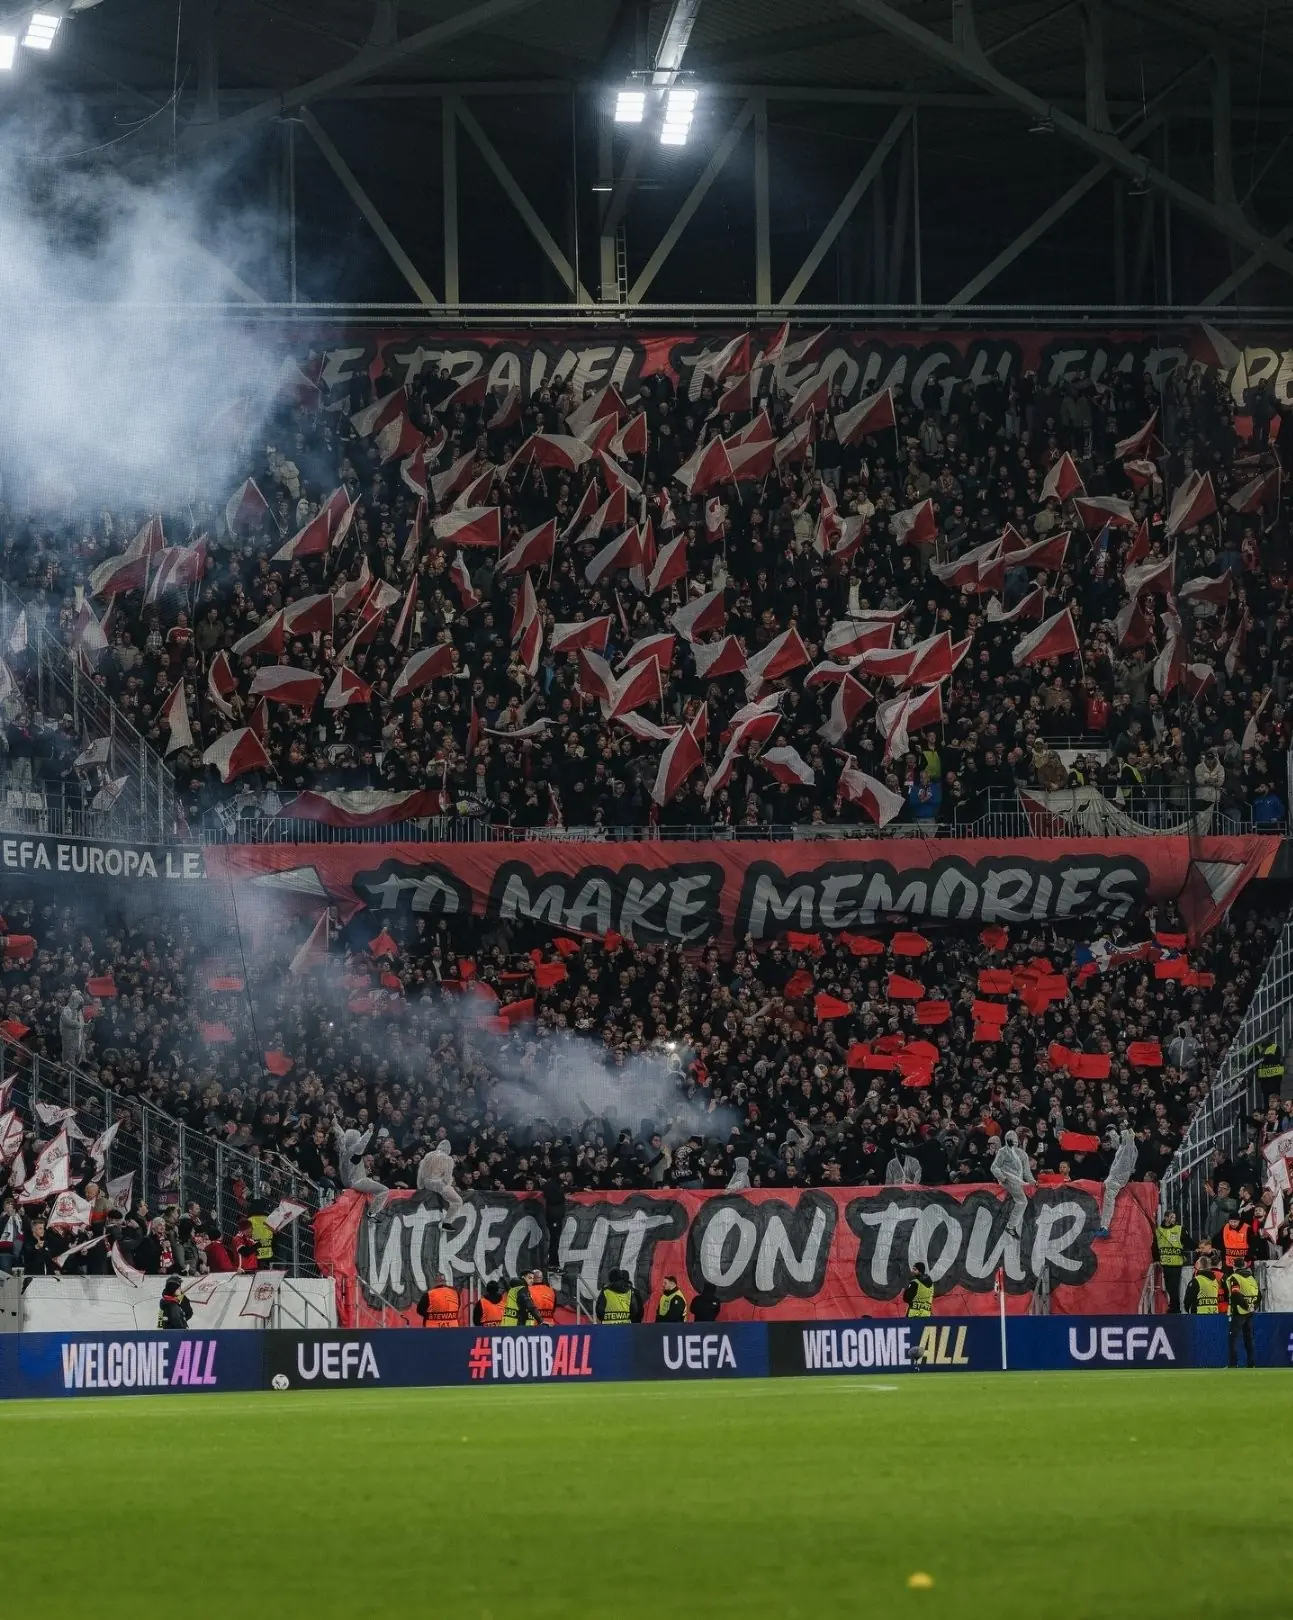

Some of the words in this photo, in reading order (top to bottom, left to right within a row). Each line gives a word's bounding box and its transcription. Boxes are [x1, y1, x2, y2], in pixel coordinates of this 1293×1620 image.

[394, 344, 642, 406] TRAVEL
[3, 840, 51, 870] EFA
[57, 846, 157, 878] EUROPA
[166, 853, 207, 879] LE
[499, 874, 712, 943] MAKE
[746, 867, 1138, 939] MEMORIES
[368, 1201, 675, 1299] UTRECHT
[700, 1206, 827, 1292] ON
[861, 1201, 1087, 1287] TOUR
[428, 1312, 458, 1321] STEWAR
[61, 1341, 170, 1389] WELCOME
[170, 1340, 218, 1386] ALL
[298, 1342, 381, 1380] UEFA
[468, 1334, 593, 1379] #FOOTBALL
[662, 1334, 738, 1370] UEFA
[802, 1327, 912, 1369] WELCOME
[917, 1325, 969, 1365] ALL
[1068, 1327, 1176, 1361] UEFA
